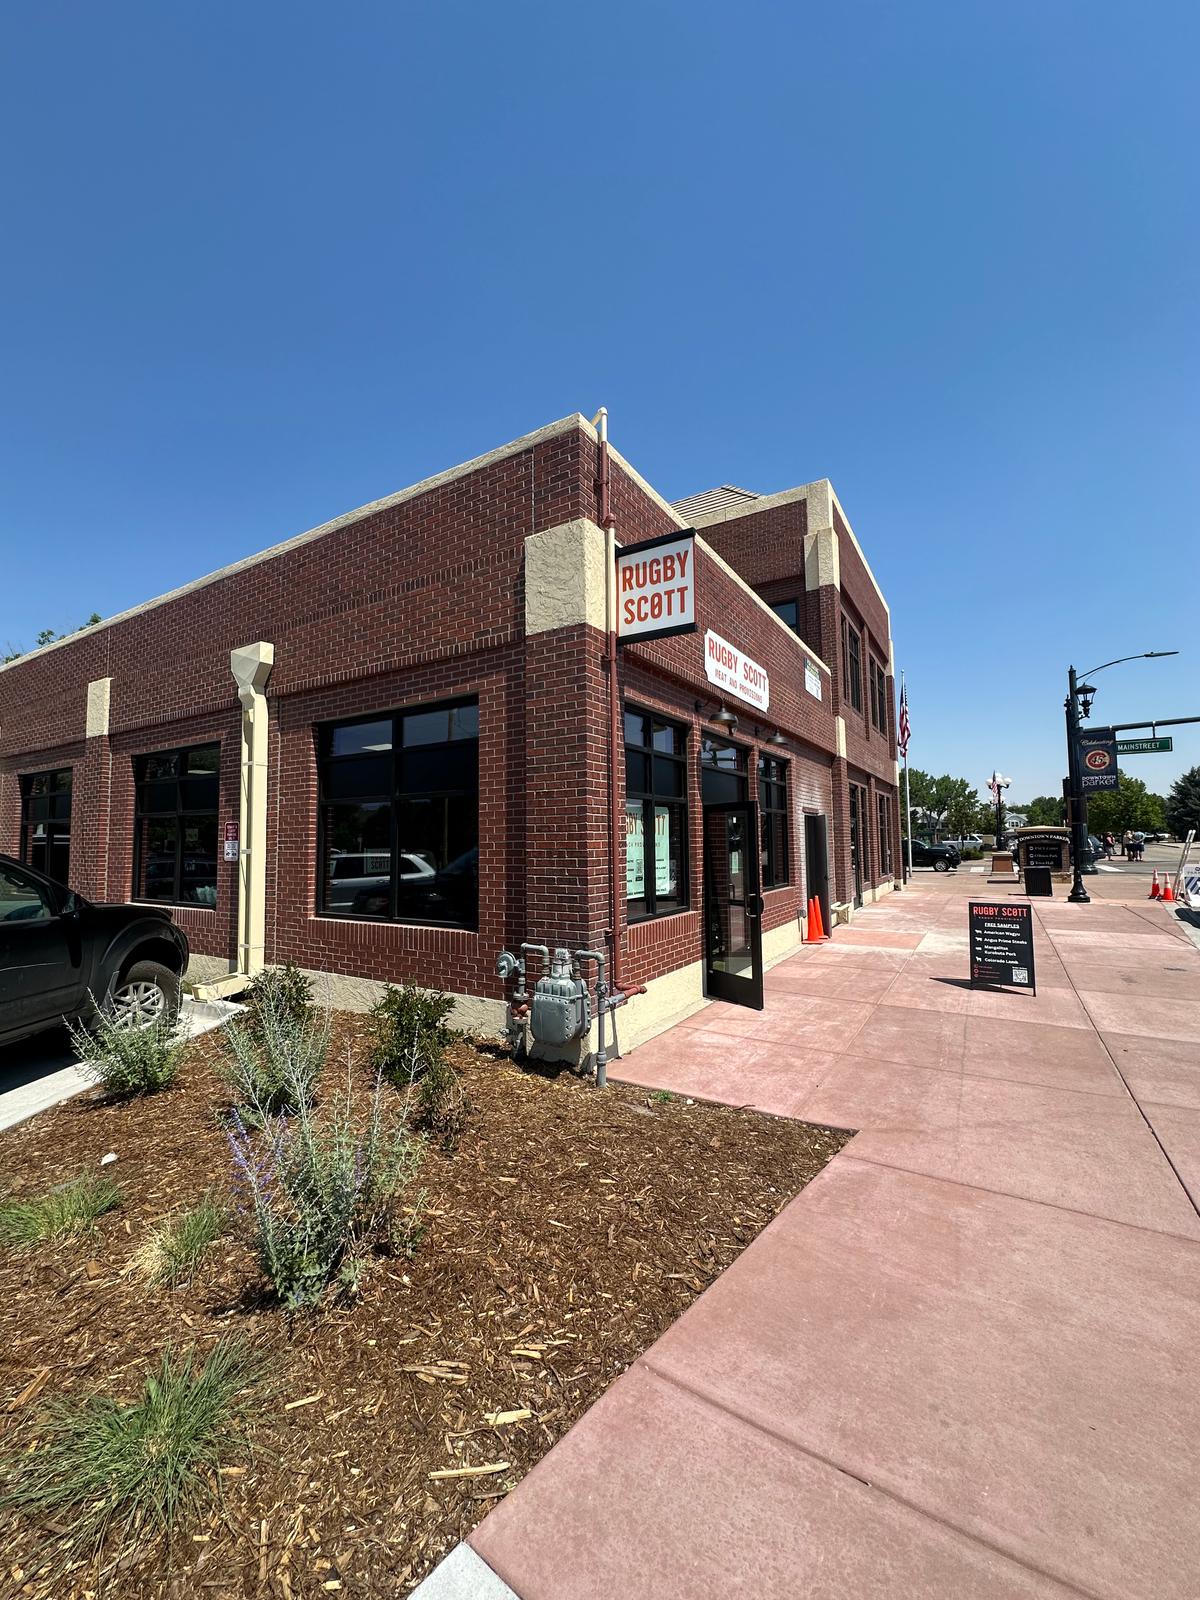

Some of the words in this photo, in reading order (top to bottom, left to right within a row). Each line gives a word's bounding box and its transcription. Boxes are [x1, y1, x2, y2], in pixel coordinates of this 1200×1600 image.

[622, 550, 688, 592] RUGBY
[708, 637, 738, 673] RUGBY
[743, 662, 767, 692] SCOTT
[715, 668, 727, 683] MEAT
[729, 677, 737, 689] AND
[1117, 742, 1160, 751] MAINSTREET
[1082, 779, 1116, 788] parker
[973, 906, 998, 916] RUGBY
